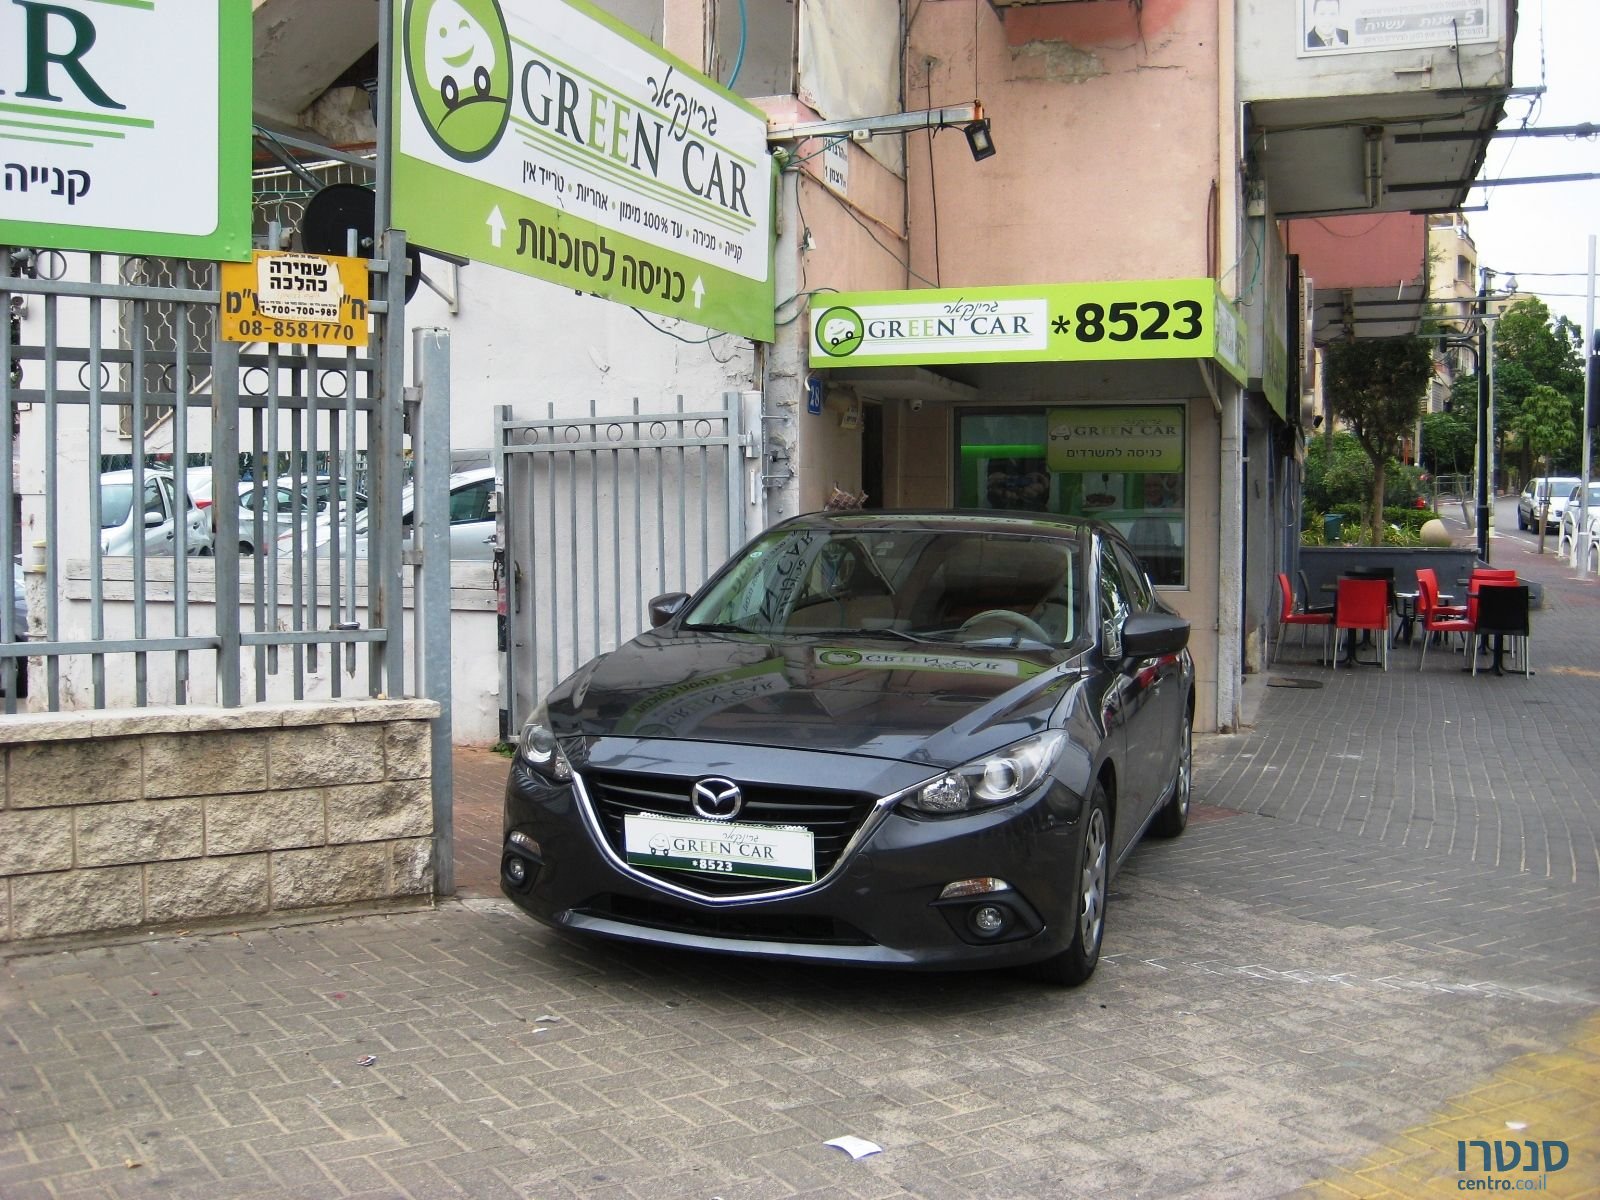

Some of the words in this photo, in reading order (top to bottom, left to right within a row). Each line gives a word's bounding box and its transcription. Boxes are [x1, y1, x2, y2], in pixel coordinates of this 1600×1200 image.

[1364, 20, 1406, 32] עשייה
[1420, 16, 1454, 28] שנות
[1463, 10, 1476, 25] 5
[646, 65, 717, 142] גרינקאר
[521, 59, 663, 177] GREEN
[682, 140, 751, 218] CAR
[522, 160, 537, 184] אין
[538, 166, 564, 193] טרייד
[5, 162, 92, 206] קנייה
[575, 183, 608, 210] אחריות
[619, 200, 641, 222] מימון
[643, 211, 668, 233] 100%
[670, 220, 683, 239] עד
[692, 228, 716, 250] מכירה
[516, 218, 616, 282] לסוכנות
[724, 241, 743, 264] קנייה
[269, 260, 328, 277] שמירה
[621, 254, 686, 303] כניסה
[269, 276, 328, 292] כהלכה
[260, 305, 338, 317] 1-700-700-989
[943, 297, 999, 321] גרינקאר
[239, 319, 354, 341] 08-8581770
[868, 318, 956, 338] GREEN
[970, 315, 1031, 336] CAR
[809, 384, 820, 408] 28
[1074, 426, 1134, 436] GREEN
[1141, 425, 1177, 436] CAR
[1066, 447, 1123, 458] למשרדים
[1127, 449, 1163, 458] כניסה
[673, 838, 731, 854] GREEN
[739, 844, 774, 859] CAR
